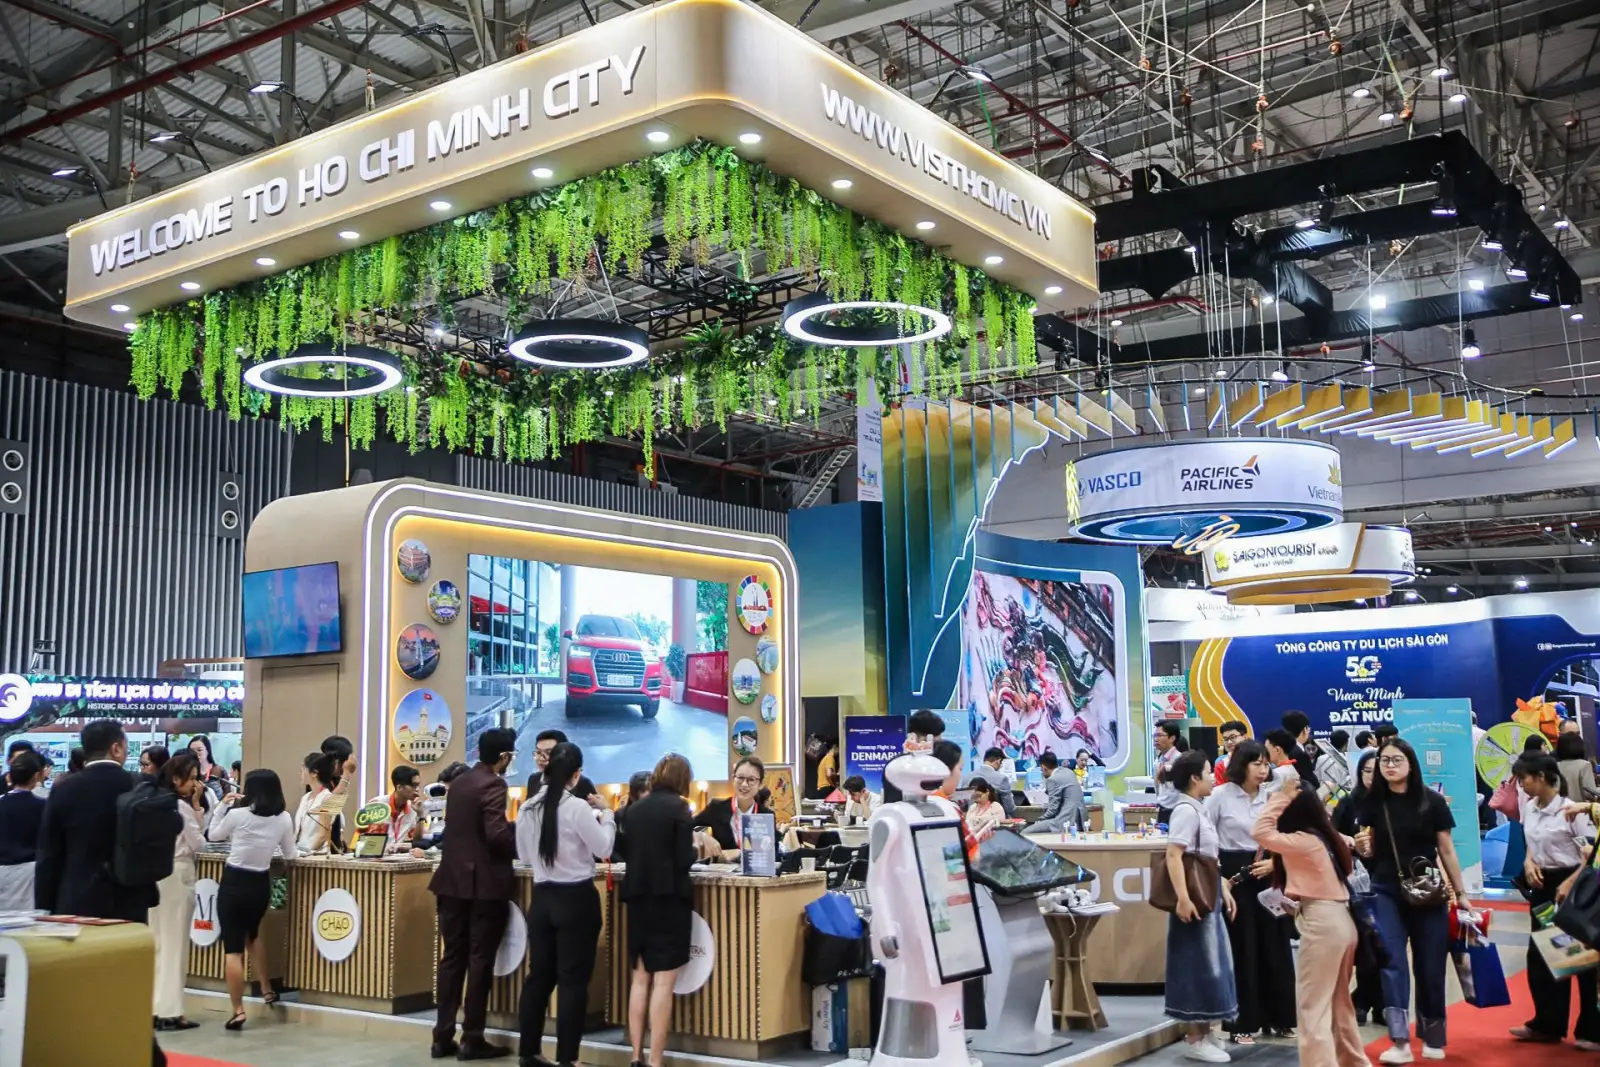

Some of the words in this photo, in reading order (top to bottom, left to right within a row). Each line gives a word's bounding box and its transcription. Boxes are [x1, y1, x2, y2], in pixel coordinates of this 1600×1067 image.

[90, 196, 233, 276] WELCOME
[243, 177, 289, 223] TO
[298, 155, 349, 206] HO
[359, 128, 415, 183] CHI
[427, 87, 531, 162] MINH
[543, 45, 647, 119] CITY
[820, 82, 1052, 241] WWW.VISITHCMC.VN
[1180, 466, 1240, 480] PACIFIC
[1088, 470, 1142, 494] VASCO
[1182, 478, 1254, 492] AIRLINES
[1233, 542, 1316, 563] SAIGONTOURIST
[1308, 639, 1341, 653] CÔNG
[1342, 639, 1357, 651] TY
[1359, 638, 1376, 649] DU
[1378, 637, 1404, 651] LỊCH
[1406, 634, 1425, 647] SÀI
[1426, 633, 1449, 646] GÒN
[1366, 686, 1405, 701] Mình
[169, 703, 191, 711] TUNNEL
[1353, 698, 1378, 709] CÙNG
[1329, 707, 1360, 723] ĐẤT
[1361, 707, 1394, 722] NƯỚ
